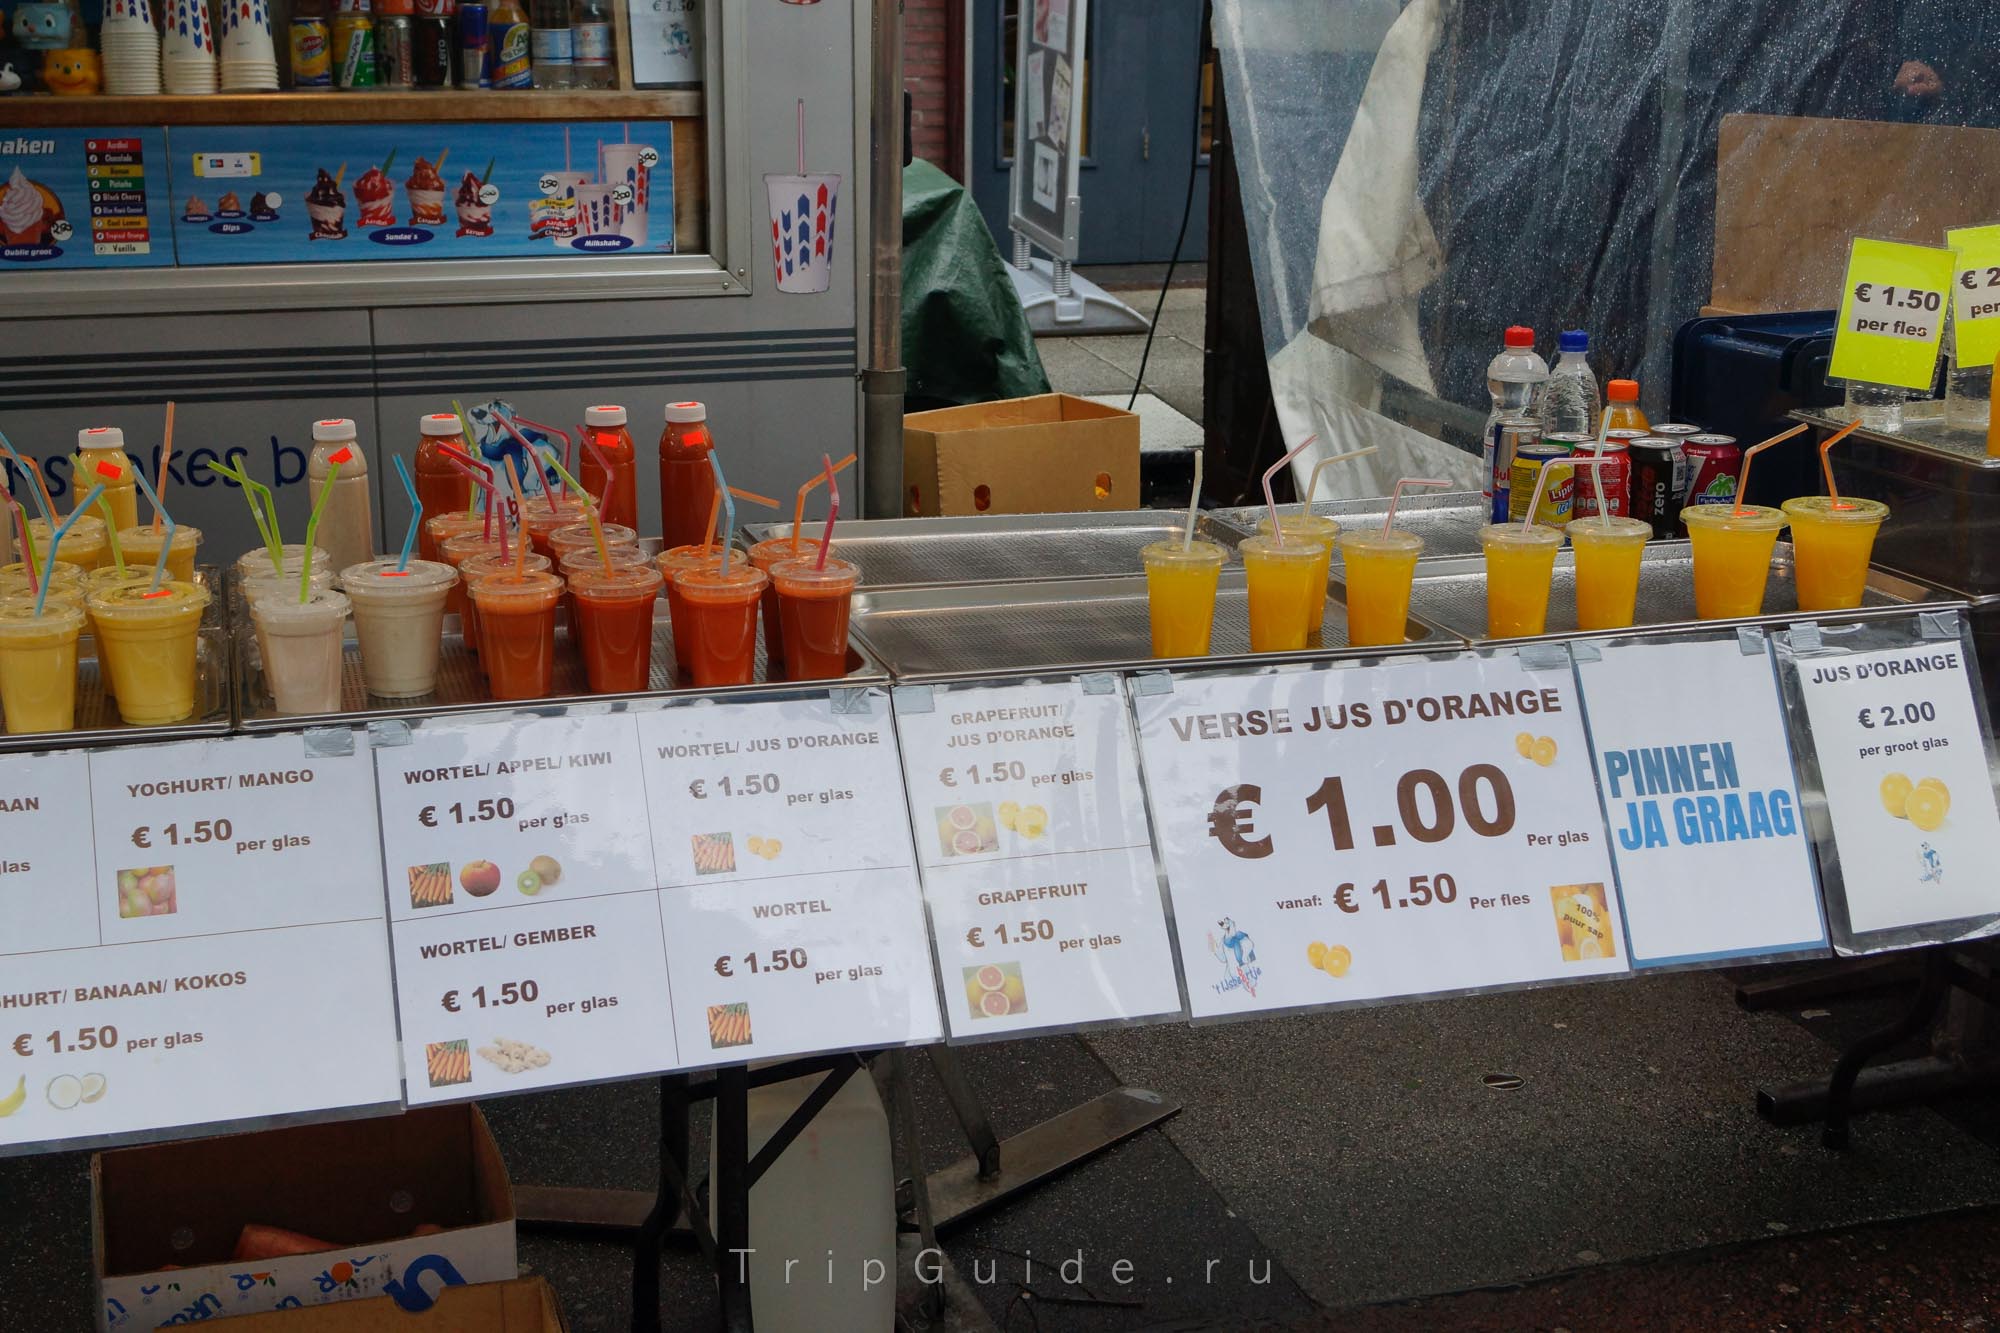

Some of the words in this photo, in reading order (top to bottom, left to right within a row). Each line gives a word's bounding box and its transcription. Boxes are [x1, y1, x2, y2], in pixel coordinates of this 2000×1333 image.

[222, 224, 241, 232] Dips
[1960, 271, 1978, 290] €
[1855, 283, 1873, 303] €
[1882, 286, 1941, 312] 1.50
[1856, 318, 1889, 332] per
[1894, 321, 1928, 337] fles
[1552, 483, 1575, 499] Lipto
[1655, 482, 1665, 516] zero
[1812, 665, 1851, 684] JUS
[1856, 654, 1959, 681] D'ORANGE
[950, 704, 1063, 726] GRAPEFRUIT/
[1168, 708, 1293, 742] VERSE
[1302, 701, 1373, 732] JUS
[1384, 688, 1563, 726] D'ORANGE
[1857, 708, 1875, 729] €
[1880, 701, 1937, 727] 2.00
[658, 741, 739, 759] WORTEL/
[746, 738, 781, 753] JUS
[787, 732, 880, 750] D'ORANGE
[948, 733, 981, 748] JUS
[987, 725, 1075, 744] D'ORANGE
[1859, 744, 1881, 758] per
[1885, 738, 1919, 756] groot
[1922, 735, 1949, 752] glas
[404, 763, 490, 785] WORTEL/
[496, 756, 562, 776] APPEL/
[568, 752, 612, 769] KIWI
[939, 767, 958, 788] €
[966, 760, 1026, 785] 1.50
[1031, 772, 1058, 787] per
[1062, 769, 1094, 785] glas
[1604, 741, 1740, 798] PINNEN
[127, 775, 232, 798] YOGHURT/
[239, 769, 314, 788] MANGO
[689, 779, 708, 800] €
[718, 773, 780, 797] 1.50
[787, 790, 814, 806] per
[819, 788, 854, 804] glas
[418, 806, 438, 827] €
[449, 797, 515, 825] 1.50
[519, 816, 547, 832] per
[553, 811, 590, 829] glas
[1207, 783, 1274, 860] €
[1305, 763, 1517, 852] 1.00
[1527, 832, 1556, 847] Per
[1557, 830, 1590, 848] glas
[1619, 800, 1669, 851] JA
[1673, 788, 1798, 845] GRAAG
[131, 826, 151, 848] €
[163, 818, 233, 847] 1.50
[236, 838, 265, 854] per
[272, 834, 311, 852] glas
[0, 860, 31, 875] las
[977, 883, 1088, 906] GRAPEFRUIT
[1276, 893, 1322, 911] vanaf:
[1333, 882, 1360, 914] €
[1372, 873, 1457, 910] 1.50
[1469, 896, 1497, 910] Per
[1500, 892, 1530, 908] fles
[753, 900, 831, 919] WORTEL
[1576, 904, 1601, 922] 100%
[966, 927, 985, 948] €
[994, 919, 1055, 945] 1.50
[1059, 937, 1085, 952] per
[1090, 933, 1122, 950] glas
[1563, 914, 1586, 929] puur
[1587, 926, 1604, 939] sap
[420, 936, 507, 960] WORTEL/
[513, 924, 596, 947] GEMBER
[714, 955, 734, 978] €
[744, 948, 808, 974] 1.50
[815, 969, 842, 984] per
[848, 964, 883, 981] glas
[0, 989, 67, 1008] HURT/
[75, 979, 167, 1002] BANAAN/
[174, 971, 247, 992] KOKOS
[441, 991, 462, 1013] €
[471, 980, 539, 1009] 1.50
[546, 1000, 575, 1017] per
[583, 995, 618, 1013] glas
[12, 1033, 34, 1057] €
[46, 1025, 118, 1054] 1.50
[127, 1037, 158, 1053] per
[164, 1031, 204, 1049] glas
